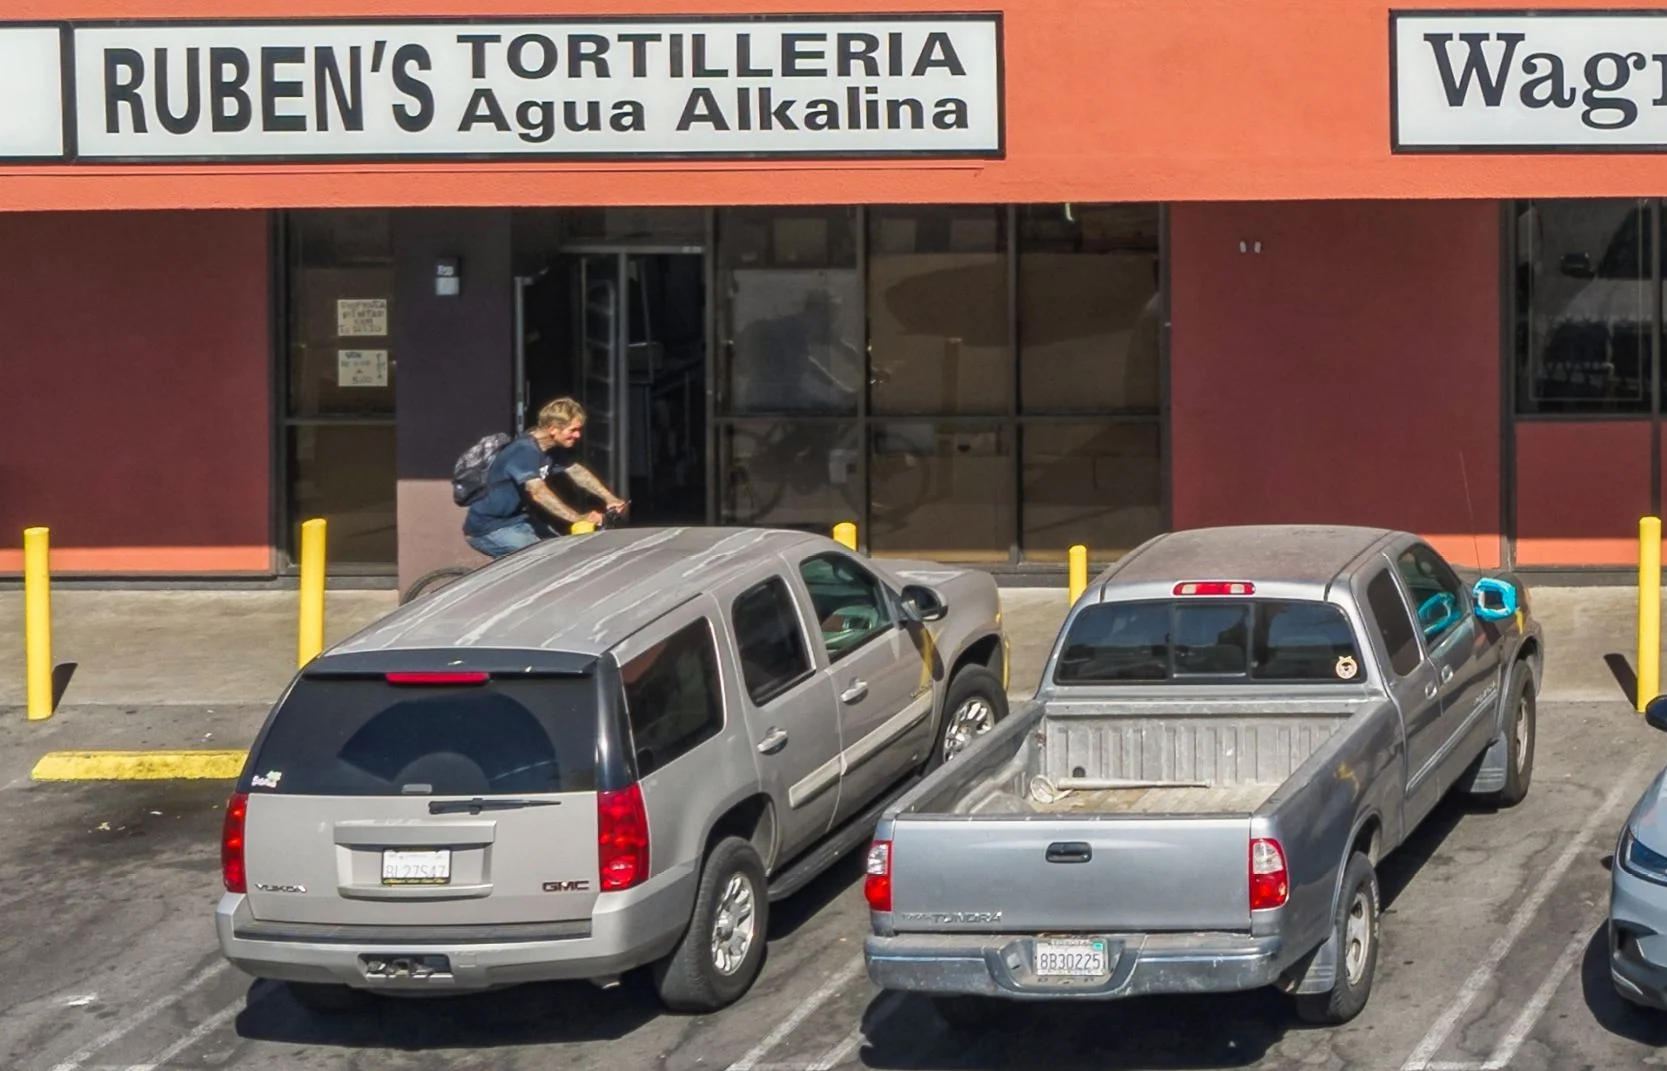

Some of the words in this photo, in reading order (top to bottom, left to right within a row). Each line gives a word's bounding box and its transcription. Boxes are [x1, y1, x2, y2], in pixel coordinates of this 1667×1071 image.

[456, 32, 967, 80] TORTILLERIA
[103, 40, 435, 135] RUBEN'S
[457, 88, 646, 144] Agua
[675, 85, 969, 131] Alkalina
[542, 880, 590, 892] GMC
[931, 912, 1002, 924] TUNDRA
[1040, 953, 1101, 970] 8B30225
